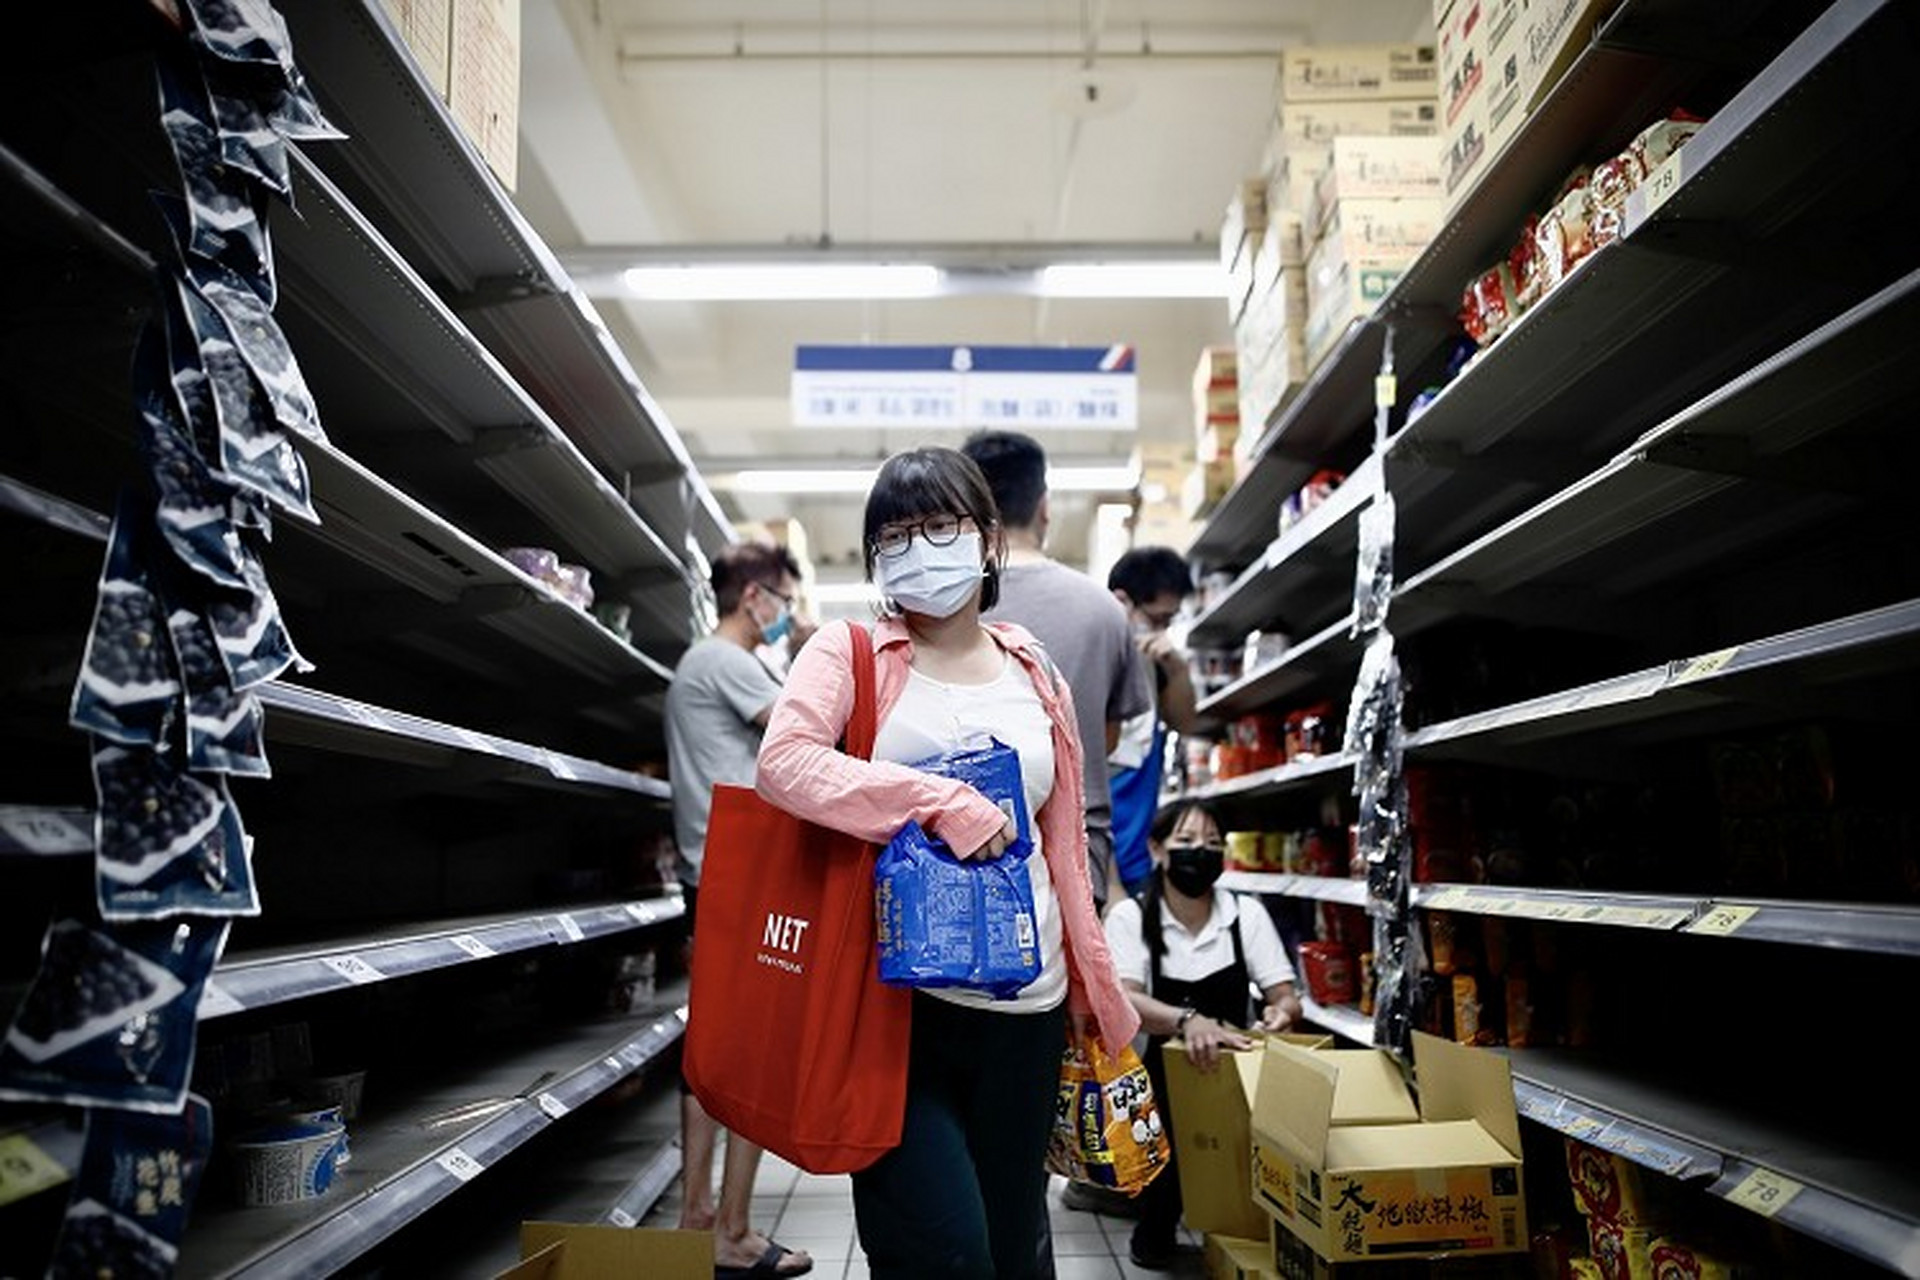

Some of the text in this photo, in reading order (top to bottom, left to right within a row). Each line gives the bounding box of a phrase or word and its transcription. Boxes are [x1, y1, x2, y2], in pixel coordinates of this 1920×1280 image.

[1653, 168, 1673, 198] 78
[762, 912, 810, 954] NET
[1747, 1180, 1781, 1202] 78
